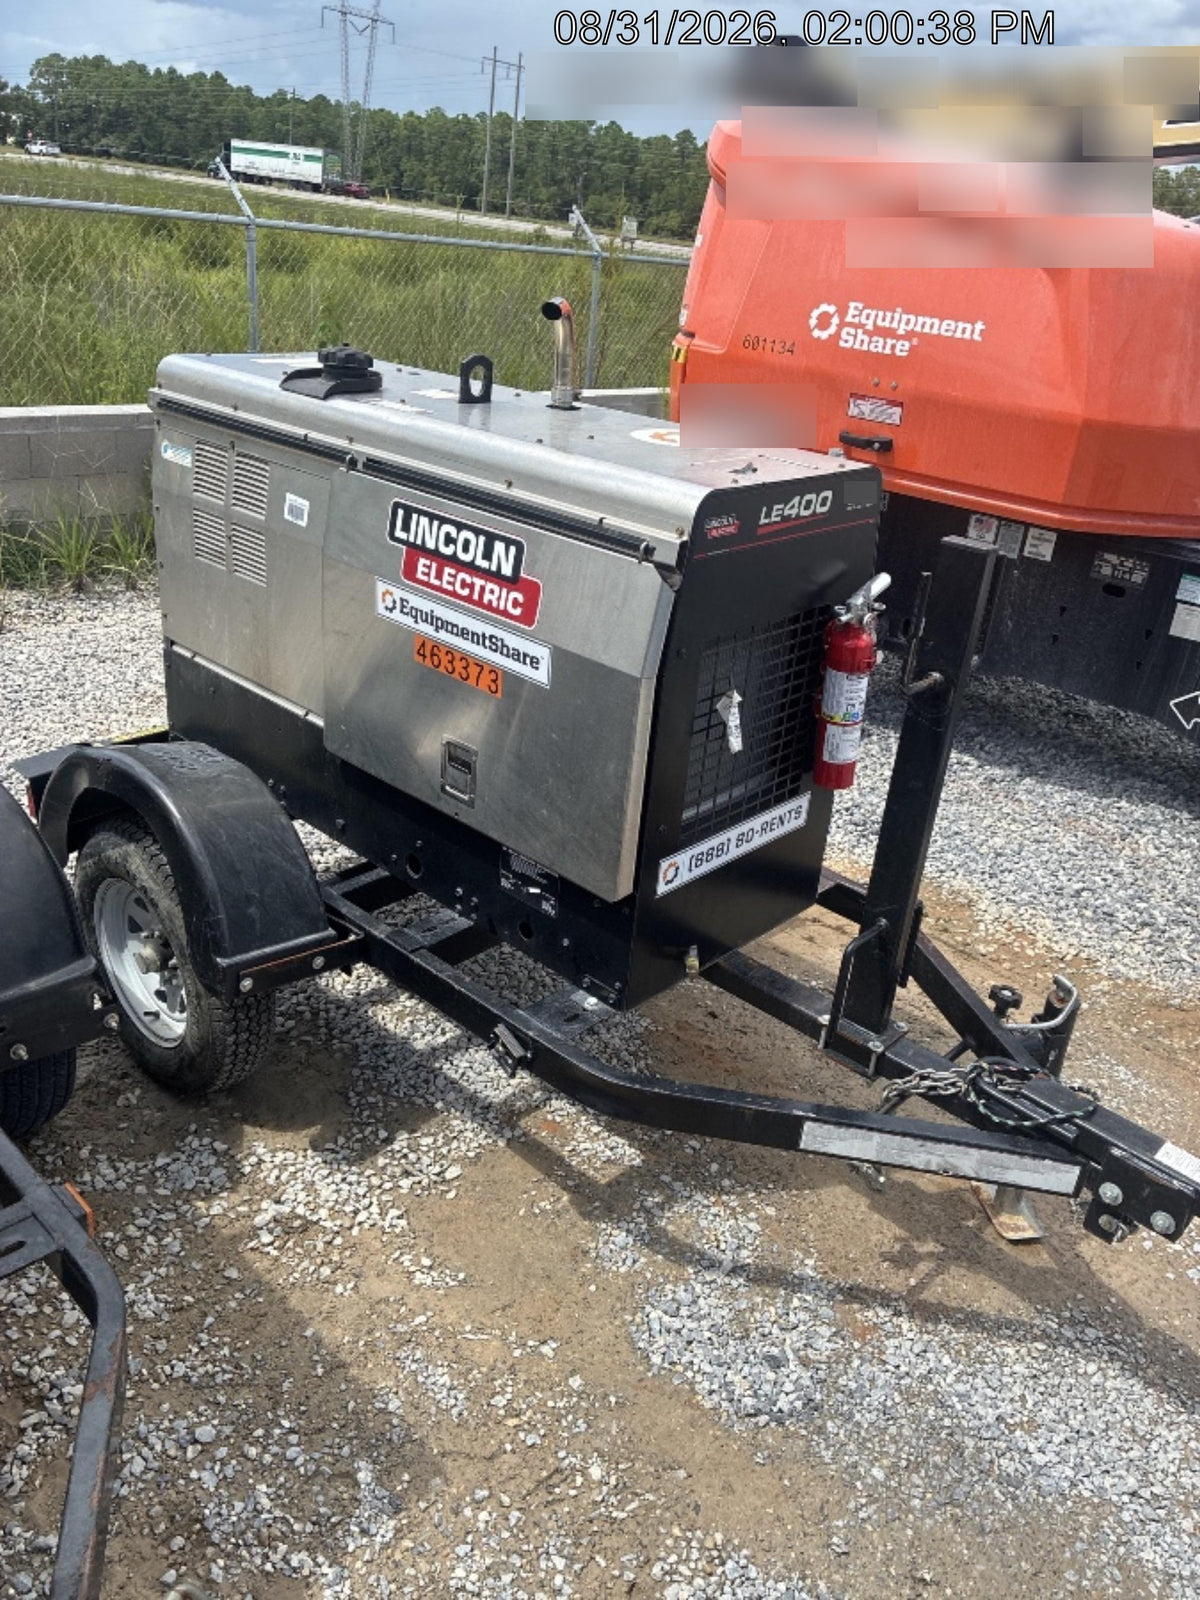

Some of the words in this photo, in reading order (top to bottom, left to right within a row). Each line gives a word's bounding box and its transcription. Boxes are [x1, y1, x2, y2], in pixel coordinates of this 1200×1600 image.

[743, 334, 796, 355] 601134
[845, 301, 986, 341] Equipment
[759, 490, 832, 524] LE400
[394, 508, 516, 577] LINCOLN
[416, 557, 523, 616] ELECTRIC
[416, 639, 499, 695] 463373
